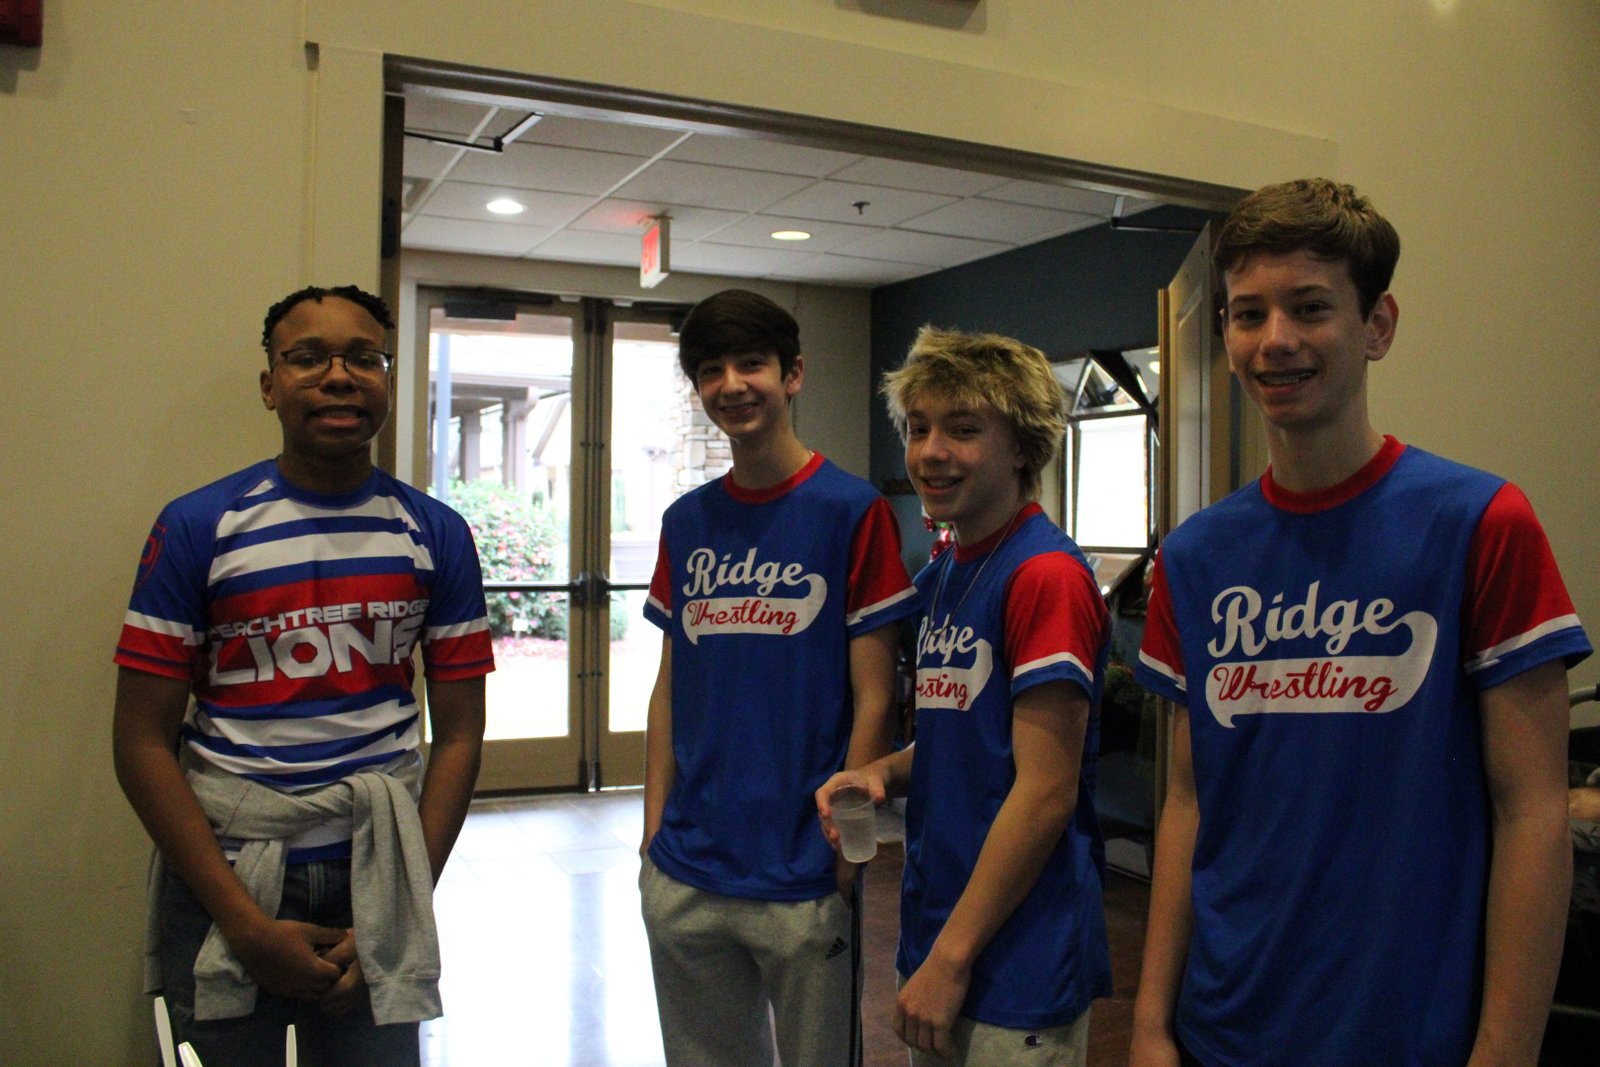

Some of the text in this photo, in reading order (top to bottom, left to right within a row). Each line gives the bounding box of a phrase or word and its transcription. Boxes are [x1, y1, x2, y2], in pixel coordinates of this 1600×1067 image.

[682, 547, 804, 597] Ridge
[687, 599, 801, 634] Wrestling
[1207, 580, 1397, 658] Ridge
[208, 614, 427, 687] LIONS
[1212, 661, 1399, 713] Wrestling
